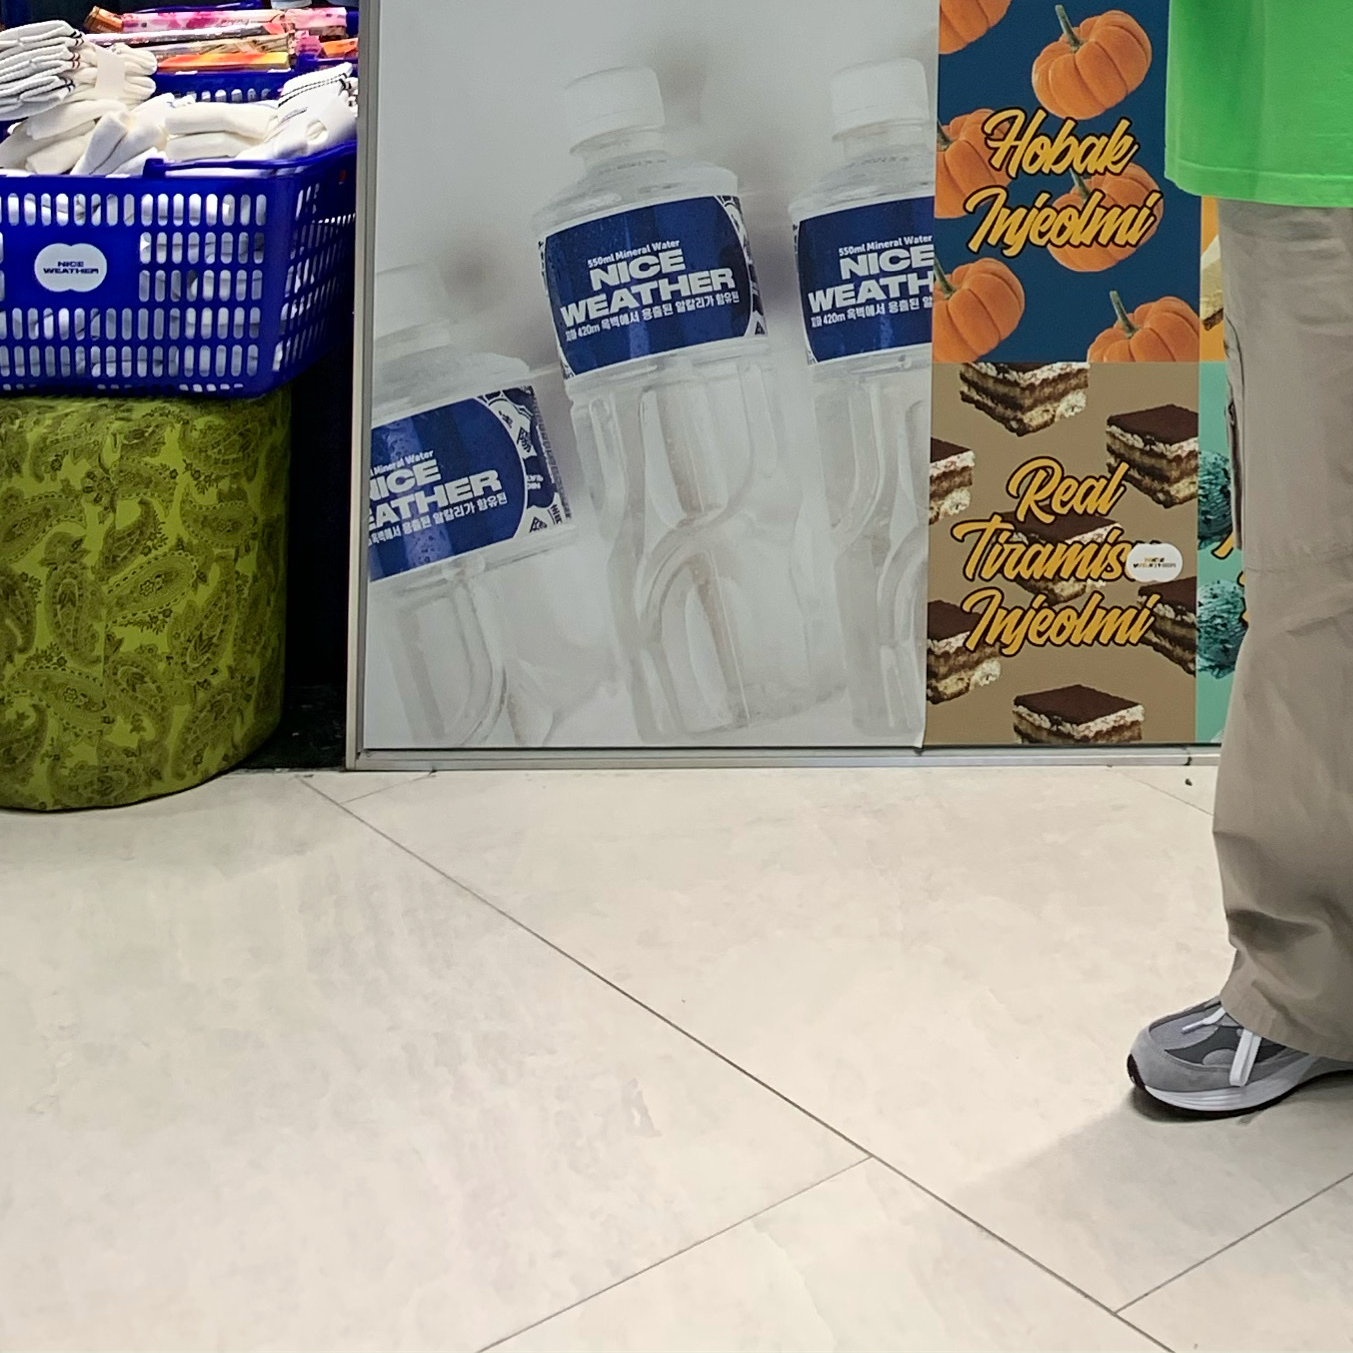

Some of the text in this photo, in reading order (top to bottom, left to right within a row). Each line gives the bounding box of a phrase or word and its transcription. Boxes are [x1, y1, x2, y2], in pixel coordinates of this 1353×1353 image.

[982, 106, 1139, 179] Hobak
[963, 185, 1163, 258] Injeolmi
[57, 260, 86, 268] NICE
[587, 238, 680, 268] 550ml Mineral Water
[838, 233, 932, 256] 550ml Mineral Water
[839, 245, 935, 280] NICE
[43, 266, 99, 276] WEATHER
[589, 249, 686, 292] NICE
[560, 268, 736, 328] WEATHER
[374, 450, 434, 476] Mineral Water
[1006, 455, 1131, 524] Real
[950, 508, 1134, 583] Tiramis
[960, 588, 1161, 657] Injeolmi
